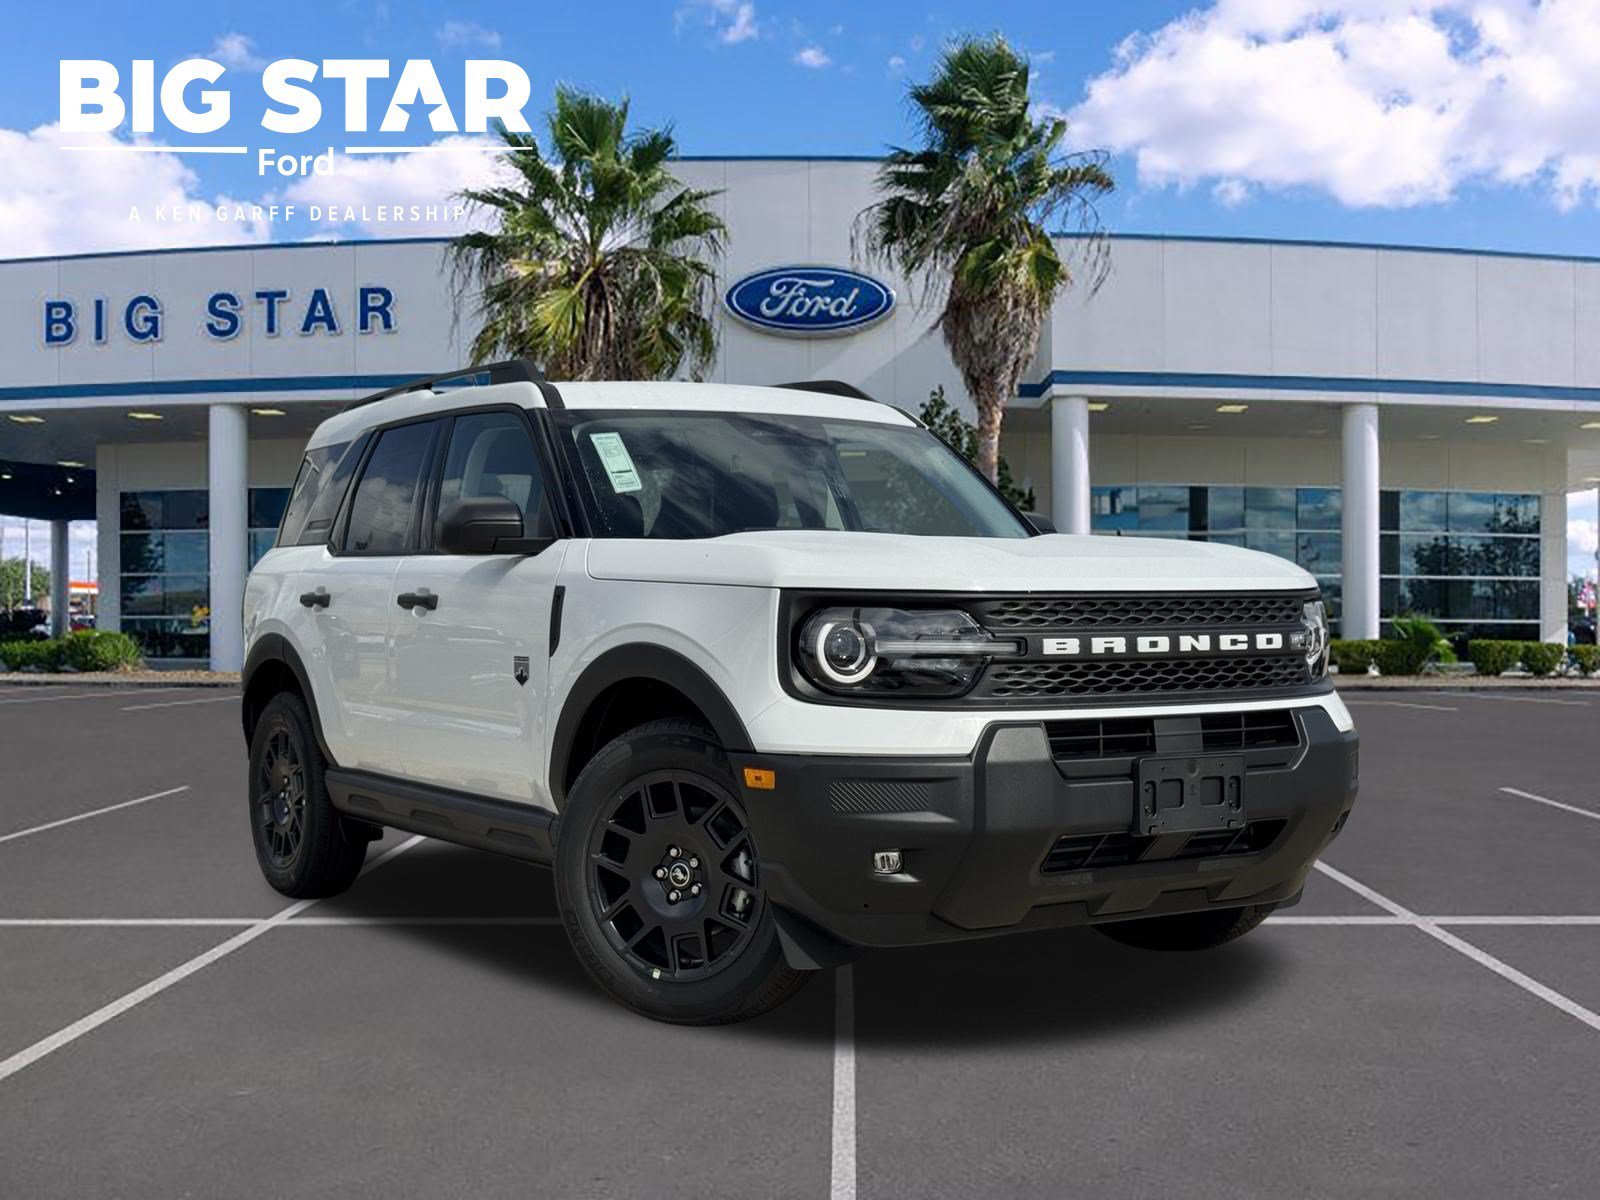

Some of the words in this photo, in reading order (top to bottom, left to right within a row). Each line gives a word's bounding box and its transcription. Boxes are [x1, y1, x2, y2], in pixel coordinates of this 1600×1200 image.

[44, 295, 164, 347] BIG
[206, 286, 398, 339] STAR
[760, 277, 859, 317] Ford
[1042, 633, 1283, 655] BRONCO
